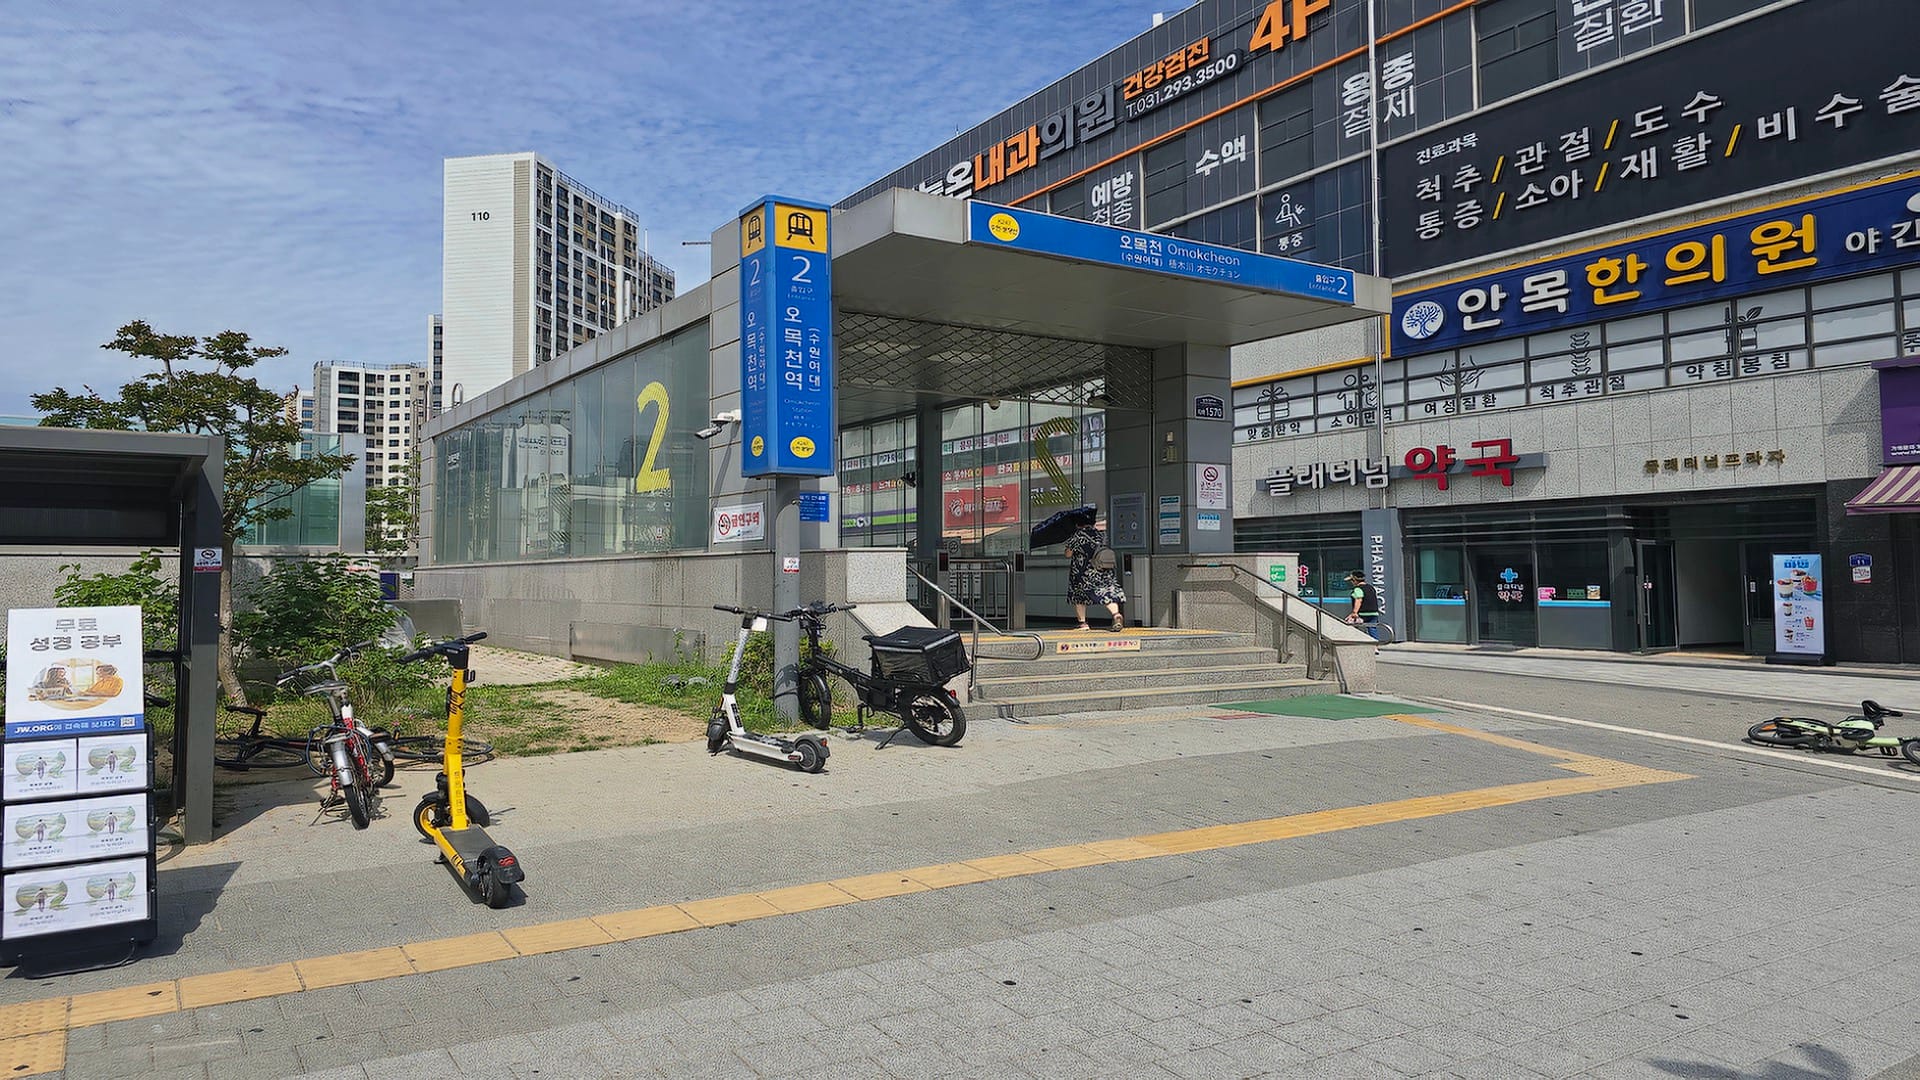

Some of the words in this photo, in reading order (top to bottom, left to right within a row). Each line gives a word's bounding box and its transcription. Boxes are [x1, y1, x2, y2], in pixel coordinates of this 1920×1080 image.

[1249, 0, 1330, 52] 4F
[1123, 36, 1209, 101] 건강검진
[1126, 53, 1237, 118] T.031.293.3500
[1342, 52, 1415, 106] 용종
[1343, 85, 1415, 138] 절제
[1195, 135, 1247, 177] 수액
[1416, 163, 1483, 203] 척추
[1513, 126, 1592, 176] 관절
[1630, 90, 1727, 140] 도수
[1416, 131, 1479, 164] 진료과목
[1091, 172, 1134, 208] 예방
[1415, 197, 1484, 241] 통증
[1514, 170, 1585, 211] 소아
[1620, 134, 1712, 180] 재활
[471, 211, 490, 221] 110
[749, 259, 761, 287] 2
[791, 255, 812, 284] 2
[1119, 235, 1162, 256] 오목천
[1167, 243, 1240, 266] Omokcheon
[1337, 276, 1348, 295] 2
[747, 311, 758, 392] 오목천역
[784, 306, 803, 390] 오목천역
[808, 327, 821, 392] (수원여대)
[636, 381, 671, 493] 2
[1206, 407, 1222, 418] 1570
[1266, 456, 1388, 497] 플래터넘
[1404, 438, 1520, 491] 약국
[731, 511, 760, 528] 금연구역
[1370, 535, 1386, 616] PHARMACY
[30, 636, 72, 652] 성경
[80, 634, 122, 649] 공부
[55, 618, 98, 633] 무료
